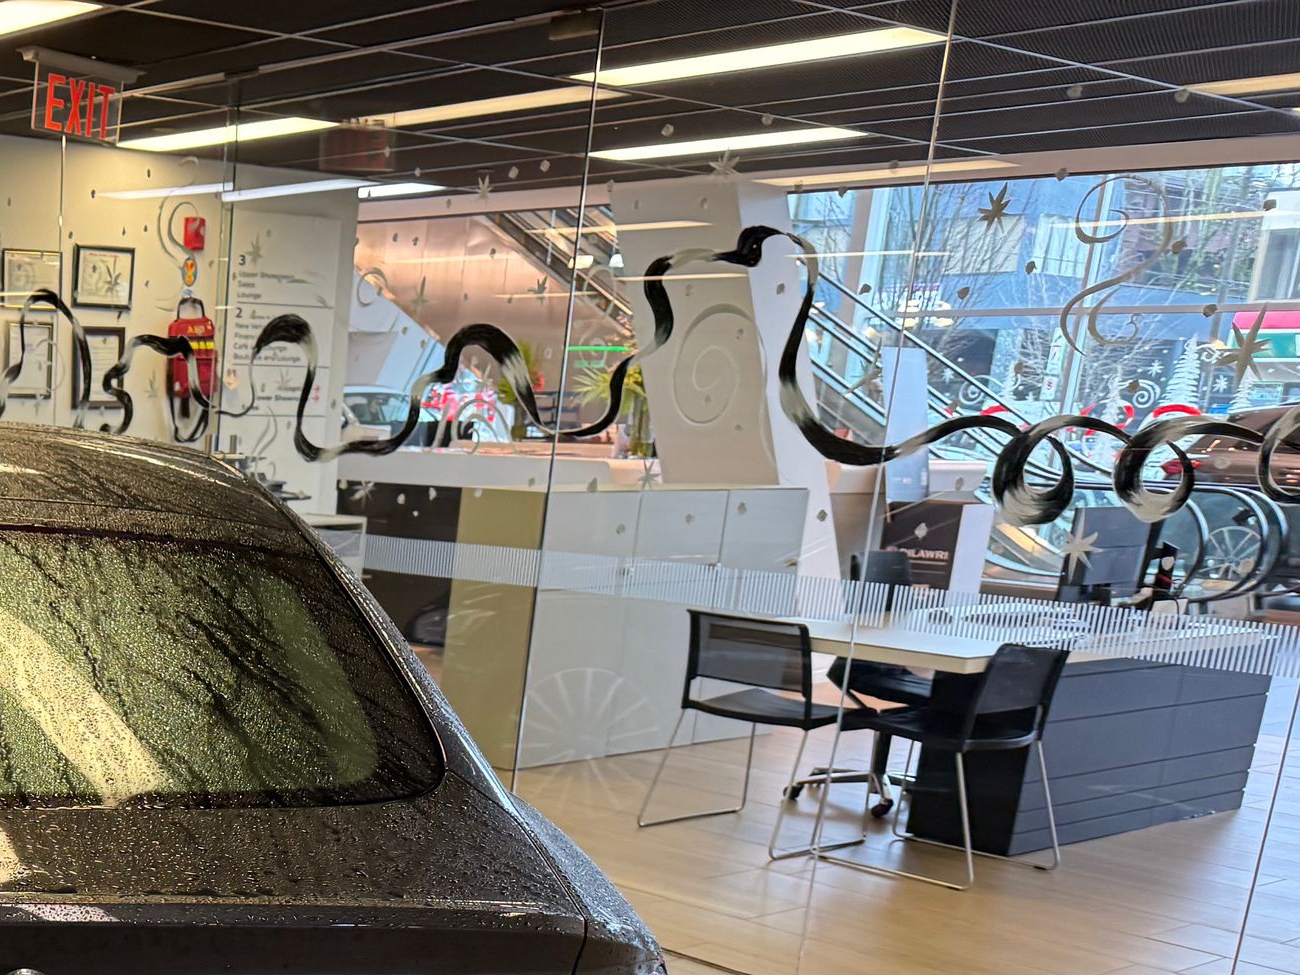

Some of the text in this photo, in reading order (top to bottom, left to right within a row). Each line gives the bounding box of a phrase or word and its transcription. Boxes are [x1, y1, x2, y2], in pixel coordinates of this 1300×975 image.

[45, 73, 116, 140] EXIT
[239, 255, 246, 265] 3
[235, 307, 243, 318] 2
